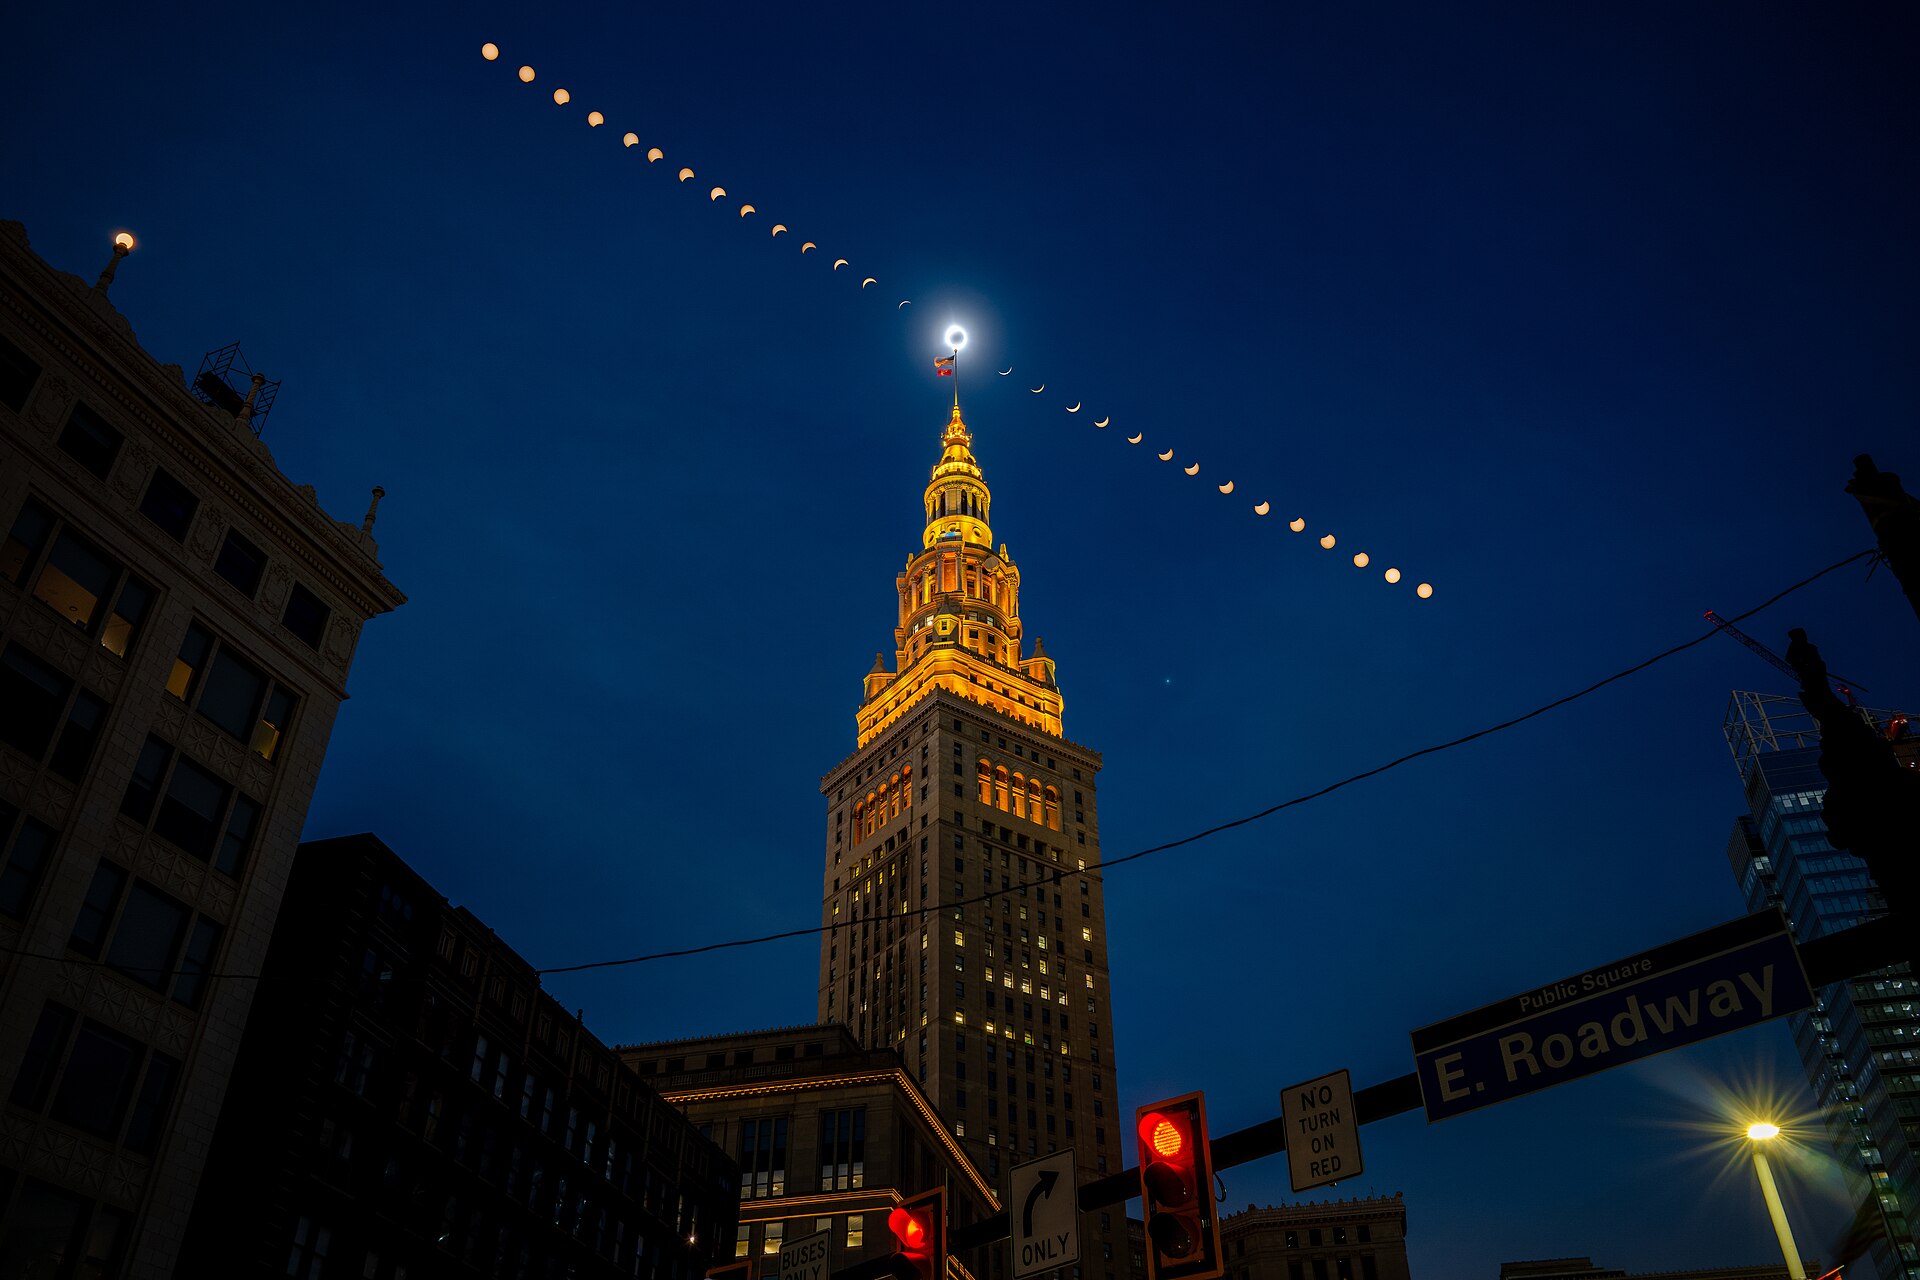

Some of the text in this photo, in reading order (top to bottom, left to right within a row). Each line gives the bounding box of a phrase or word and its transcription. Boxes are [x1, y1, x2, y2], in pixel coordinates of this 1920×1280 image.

[1519, 958, 1652, 1012] Public Square
[1434, 963, 1775, 1103] E. Roadway
[1300, 1085, 1333, 1112] NO
[1298, 1107, 1341, 1135] TURN
[1311, 1132, 1335, 1154] ON
[1310, 1155, 1342, 1179] RED
[782, 1240, 826, 1271] BUSES
[1022, 1231, 1070, 1267] ONLY
